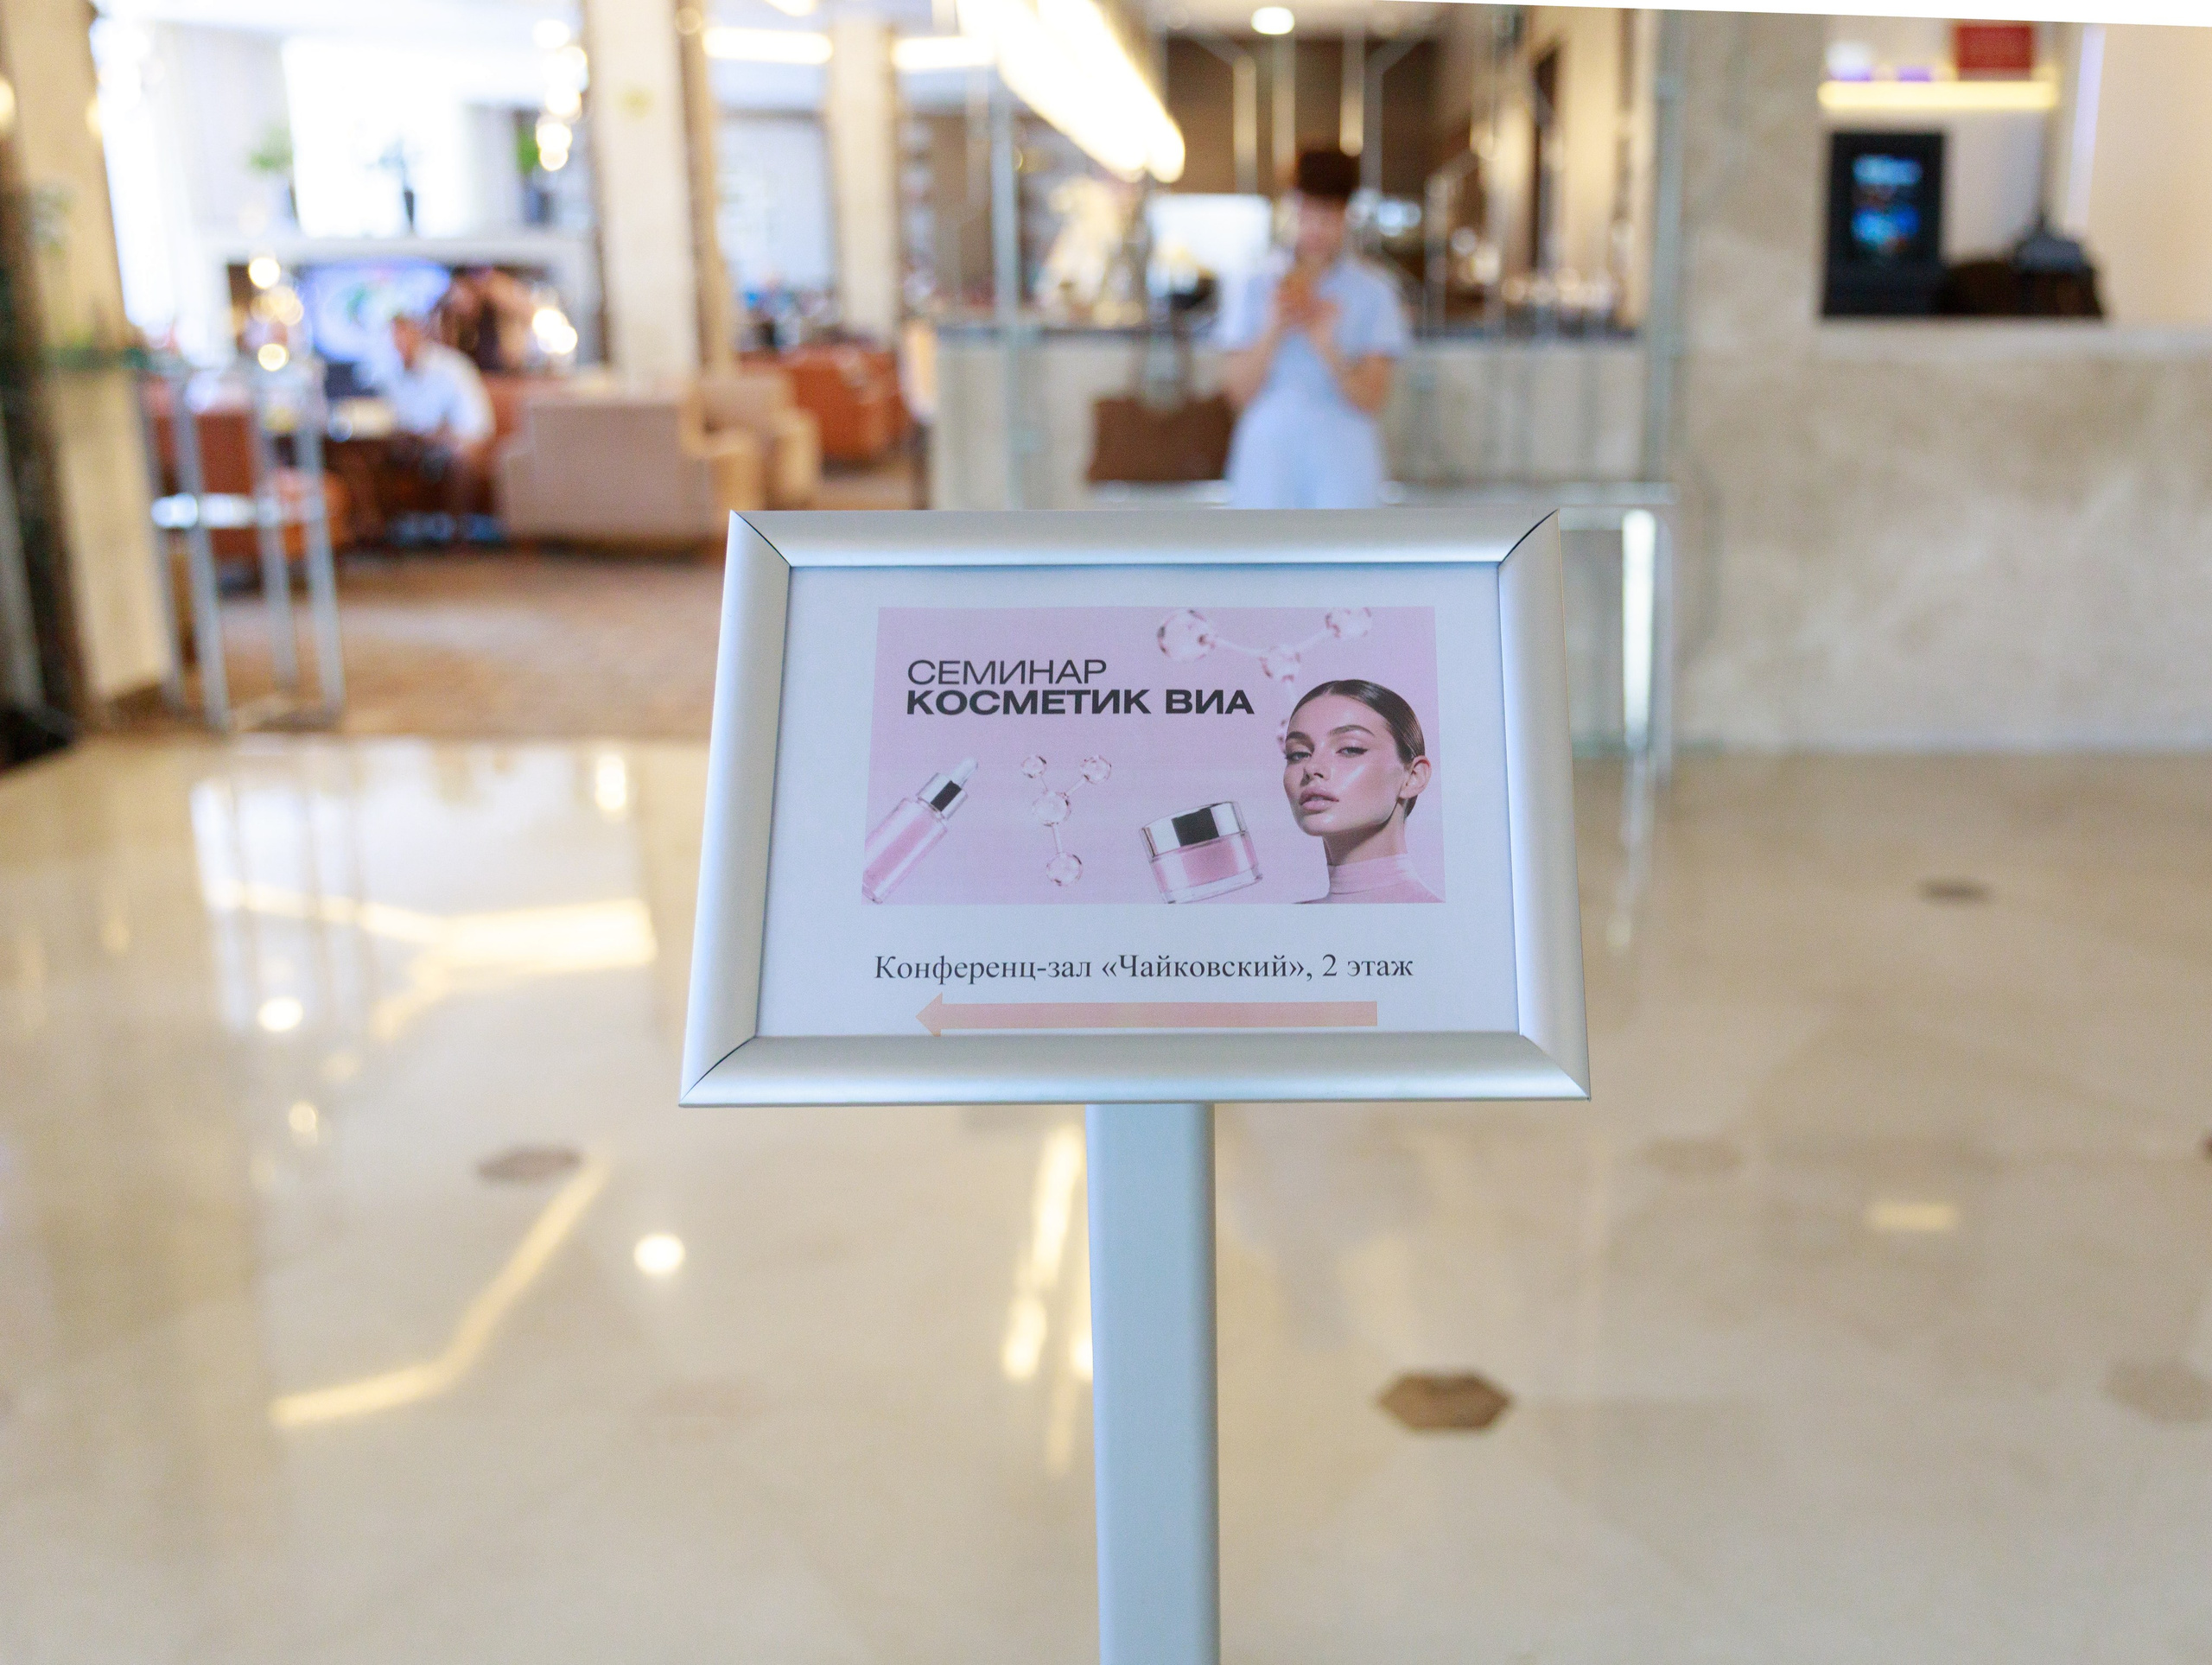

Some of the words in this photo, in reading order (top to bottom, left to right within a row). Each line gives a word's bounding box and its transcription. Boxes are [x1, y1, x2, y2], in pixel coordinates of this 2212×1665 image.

[908, 659, 1106, 685] СЕМИНАР
[907, 690, 1151, 715] КОСМЕТИК
[1166, 690, 1255, 714] ВИА
[876, 956, 1090, 984] Конференц-зал
[1103, 955, 1312, 980] «Чайковский»,
[1323, 954, 1337, 976] 2
[1348, 961, 1413, 976] этаж
